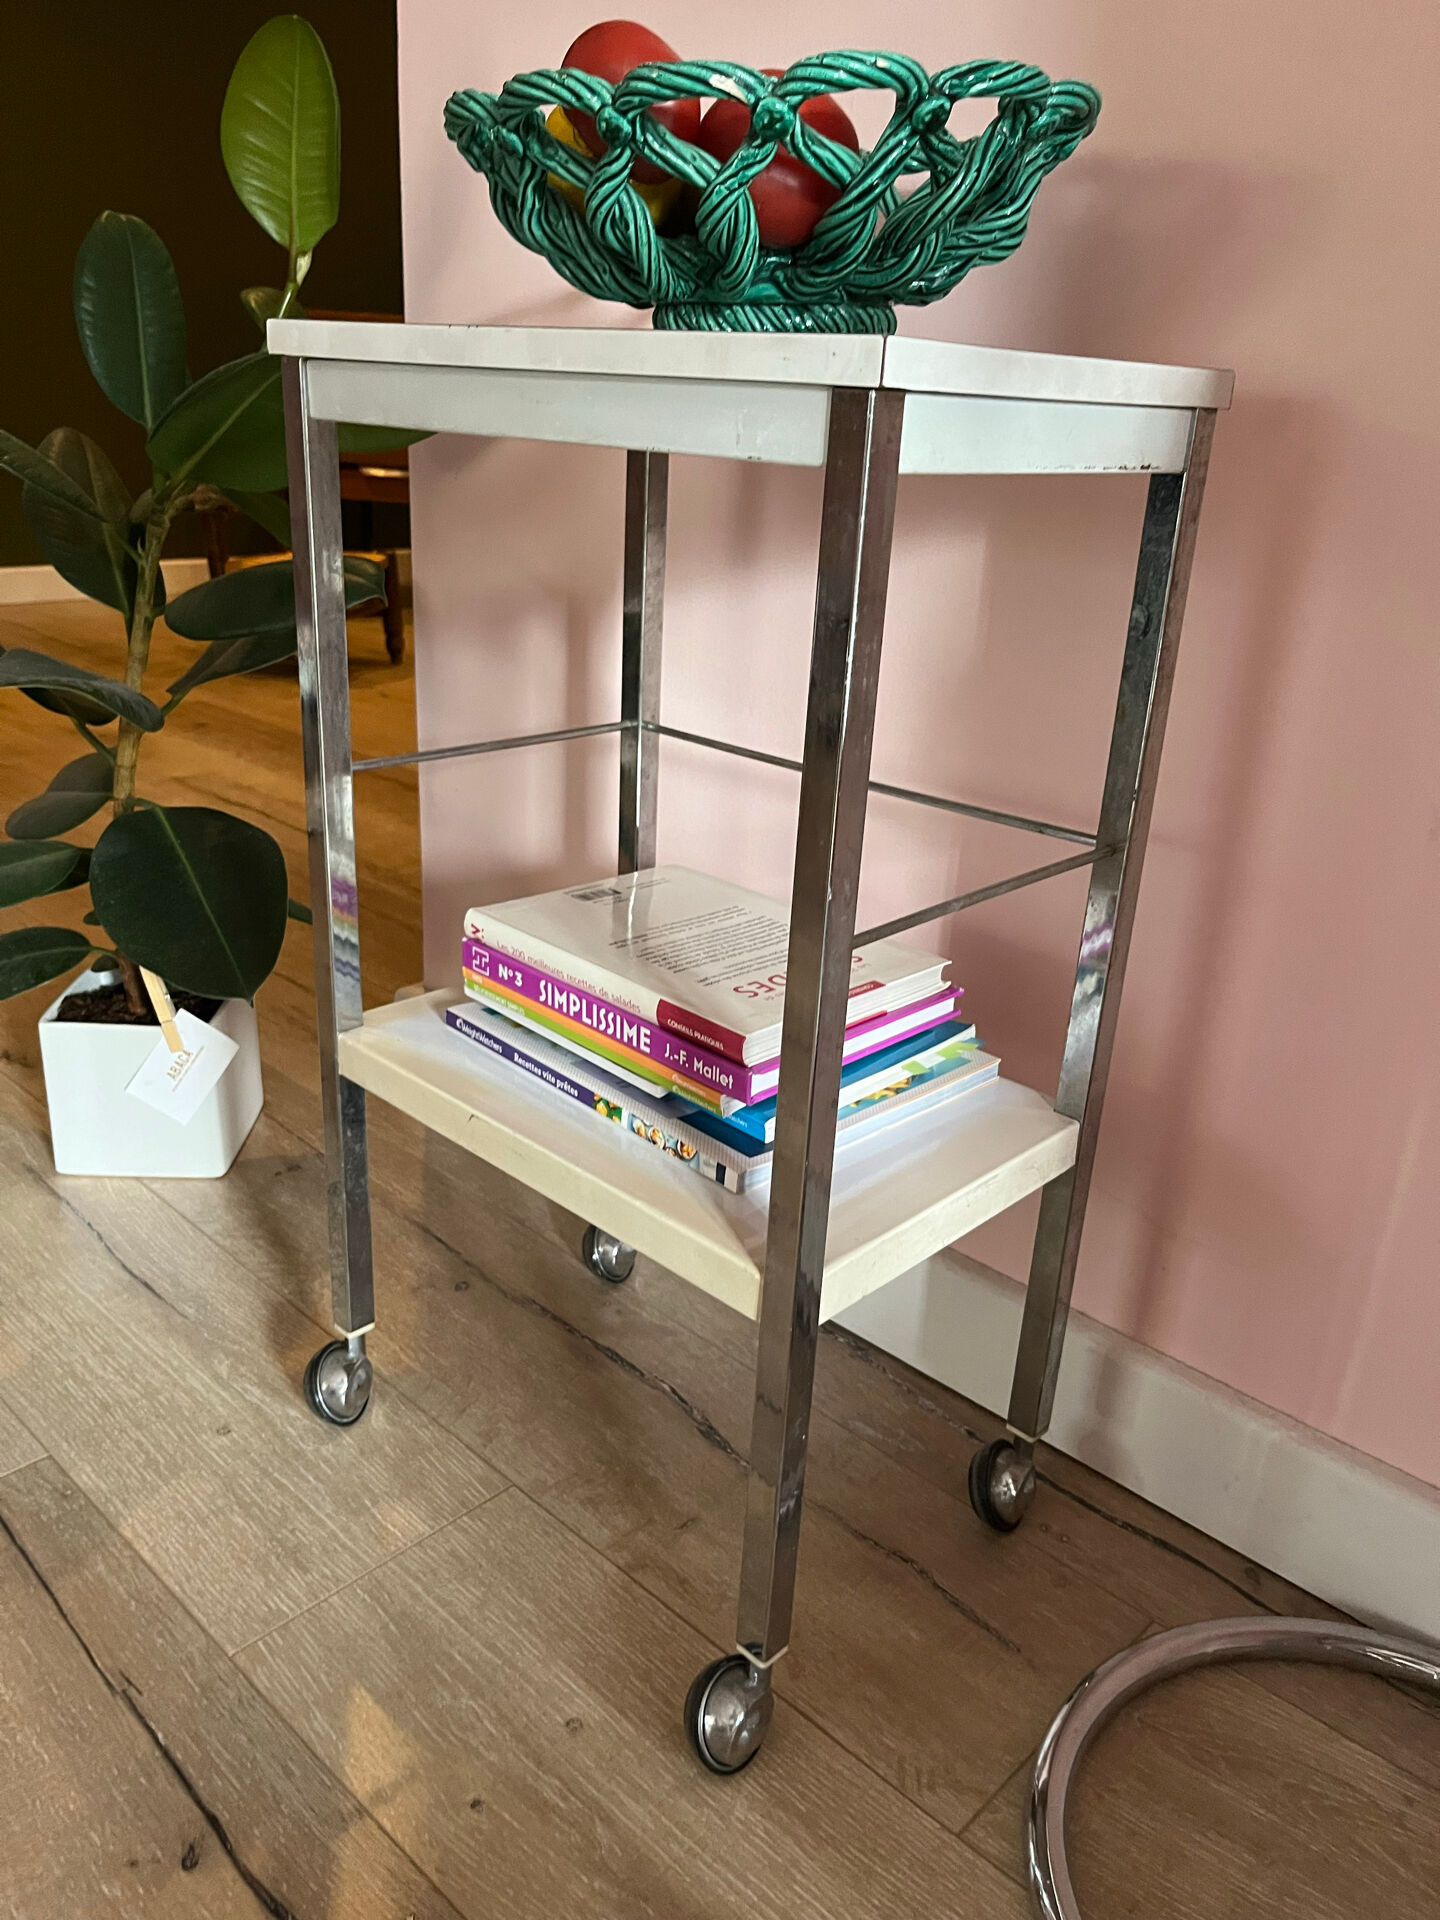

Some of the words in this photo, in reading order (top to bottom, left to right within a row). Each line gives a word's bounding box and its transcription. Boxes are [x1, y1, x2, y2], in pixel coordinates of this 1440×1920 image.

[510, 946, 525, 960] 200
[527, 953, 565, 980] meilleures
[566, 973, 597, 993] recettes
[599, 986, 609, 998] de
[611, 993, 640, 1014] salades
[539, 979, 651, 1054] SIMPLISSIME
[667, 1018, 693, 1037] CONSEILS
[694, 1030, 724, 1051] PRATIQUES
[513, 1052, 541, 1076] Recettes
[542, 1069, 556, 1084] vite
[556, 1080, 579, 1098] prêtes
[664, 1043, 689, 1068] J.-F.
[693, 1057, 733, 1089] Mallet
